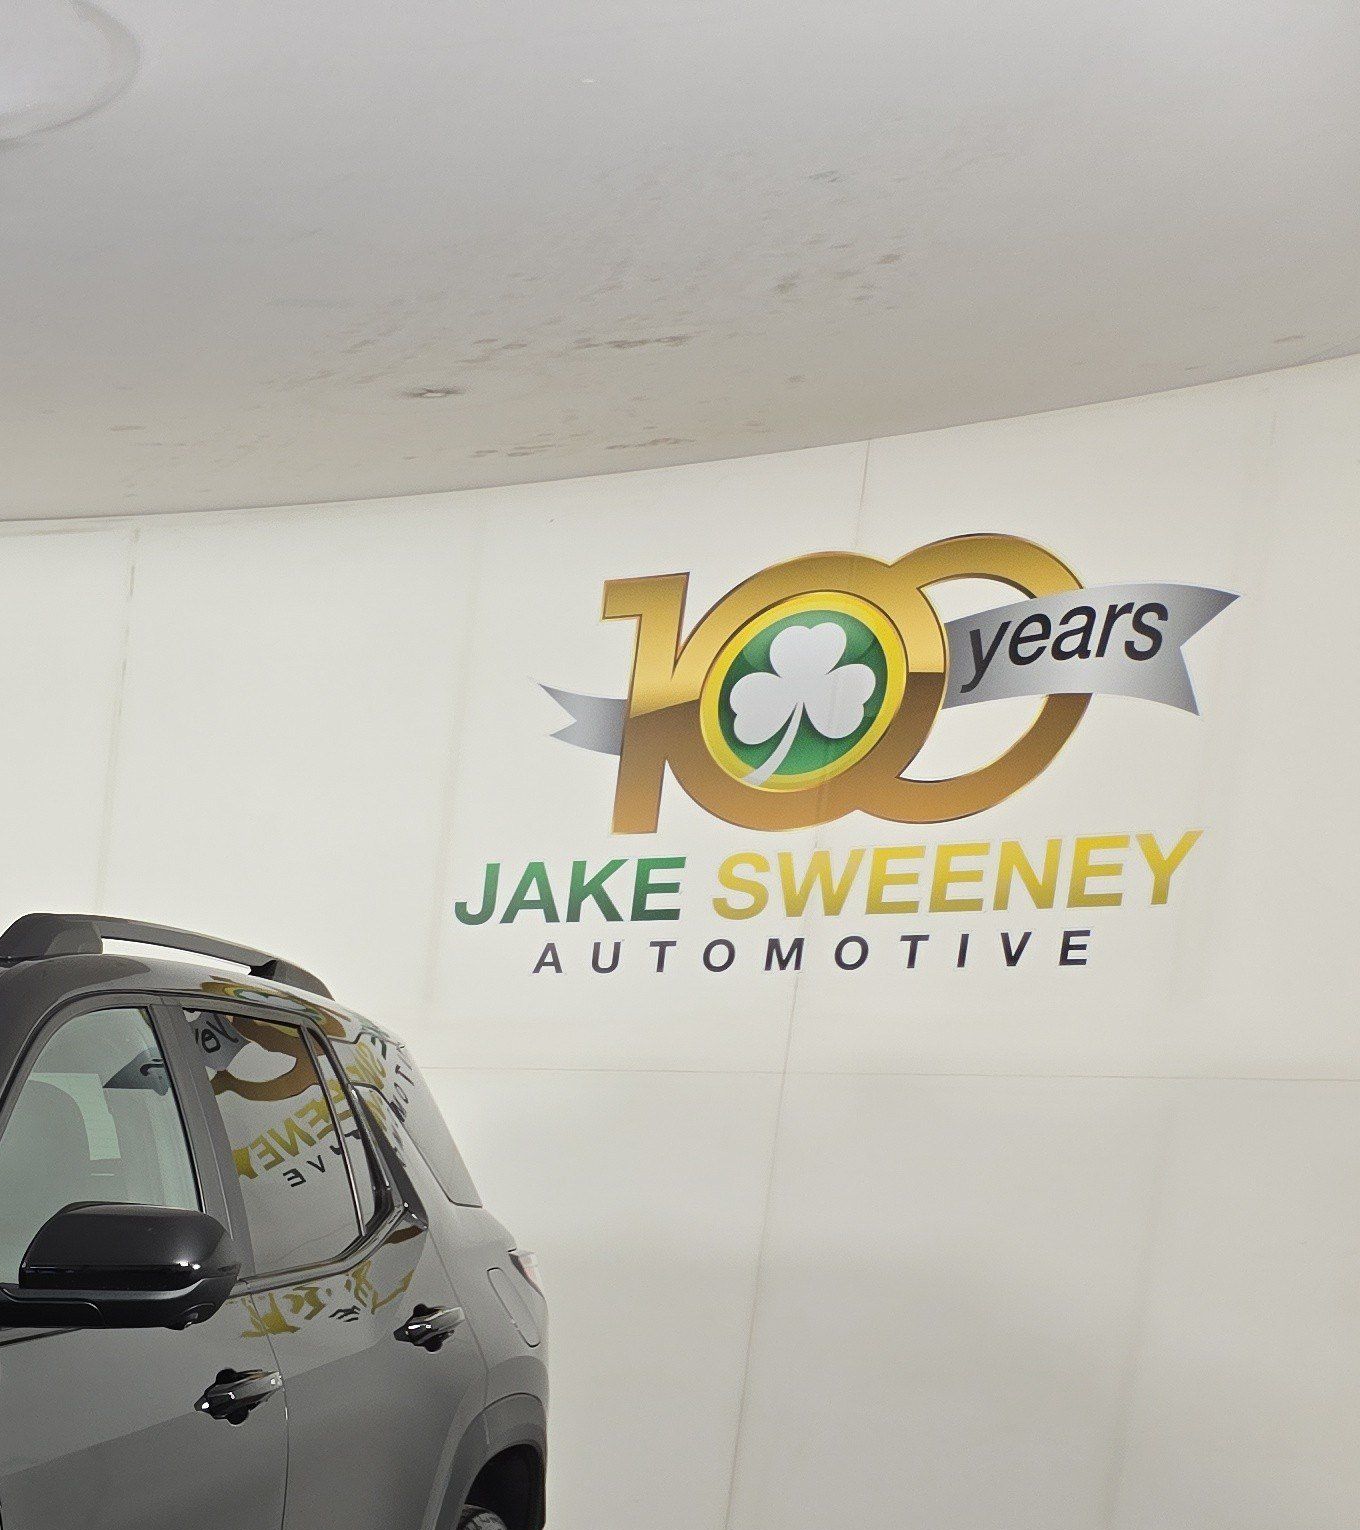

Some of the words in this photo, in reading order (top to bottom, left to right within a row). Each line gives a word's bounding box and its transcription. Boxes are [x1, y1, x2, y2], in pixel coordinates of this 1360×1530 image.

[602, 533, 1093, 834] 100
[960, 601, 1168, 693] years
[454, 856, 687, 925] JAKE
[711, 830, 1203, 922] SWEENEY
[532, 930, 1093, 975] AUTOMOTIVE
